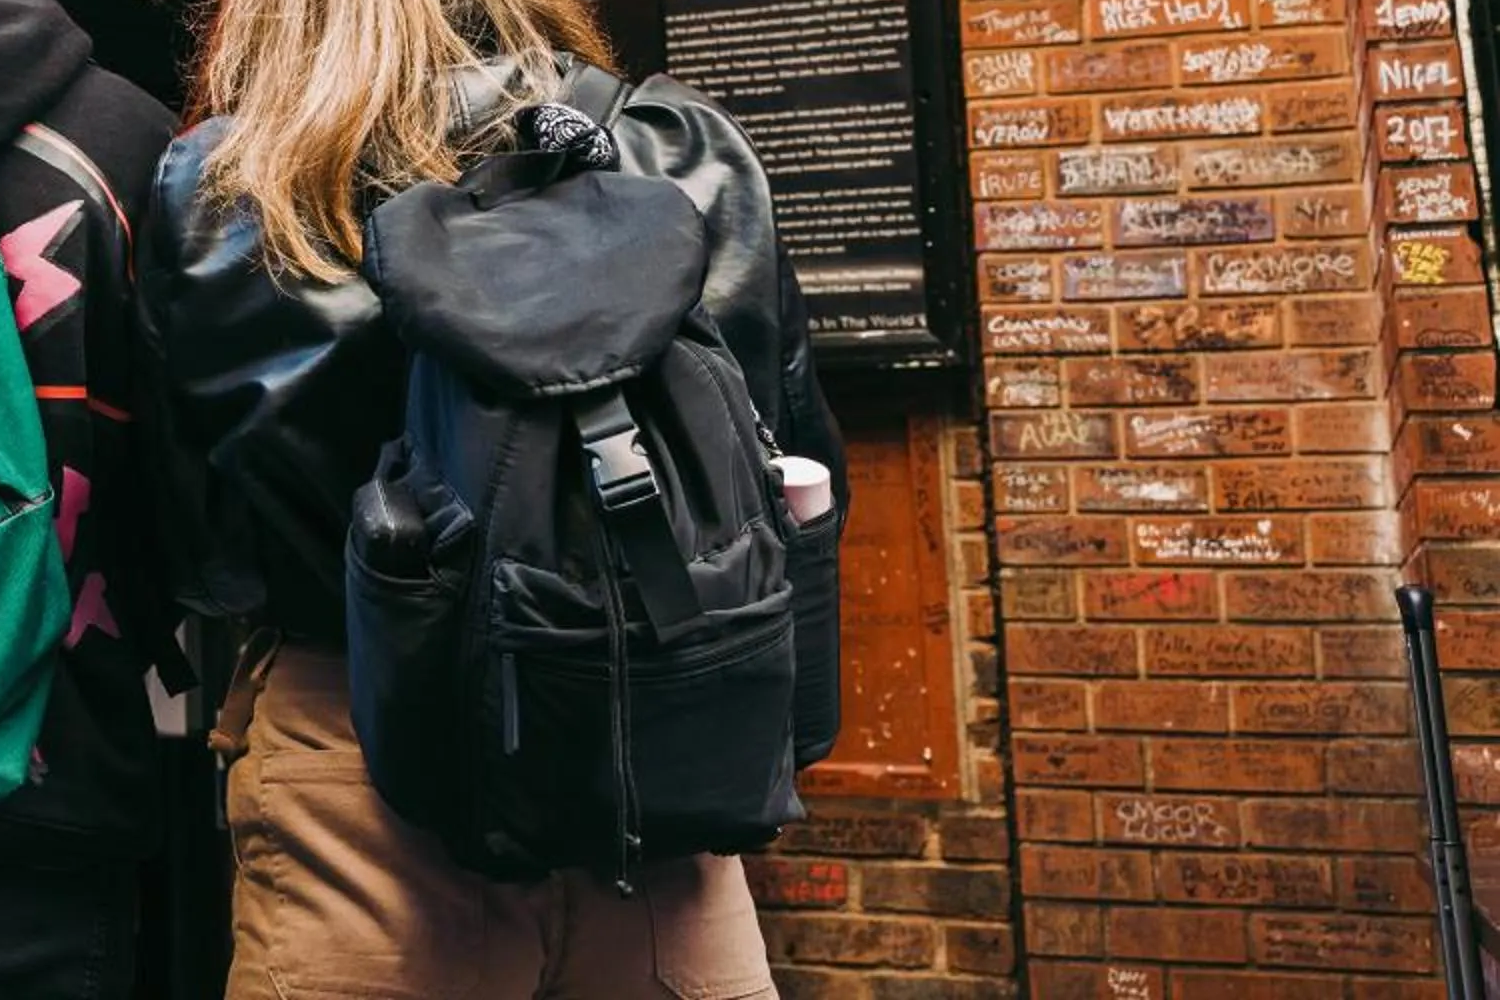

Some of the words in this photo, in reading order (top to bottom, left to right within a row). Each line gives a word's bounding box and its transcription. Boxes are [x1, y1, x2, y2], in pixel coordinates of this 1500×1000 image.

[1378, 59, 1457, 93] NIGEL
[840, 315, 868, 329] The
[869, 314, 916, 329] World
